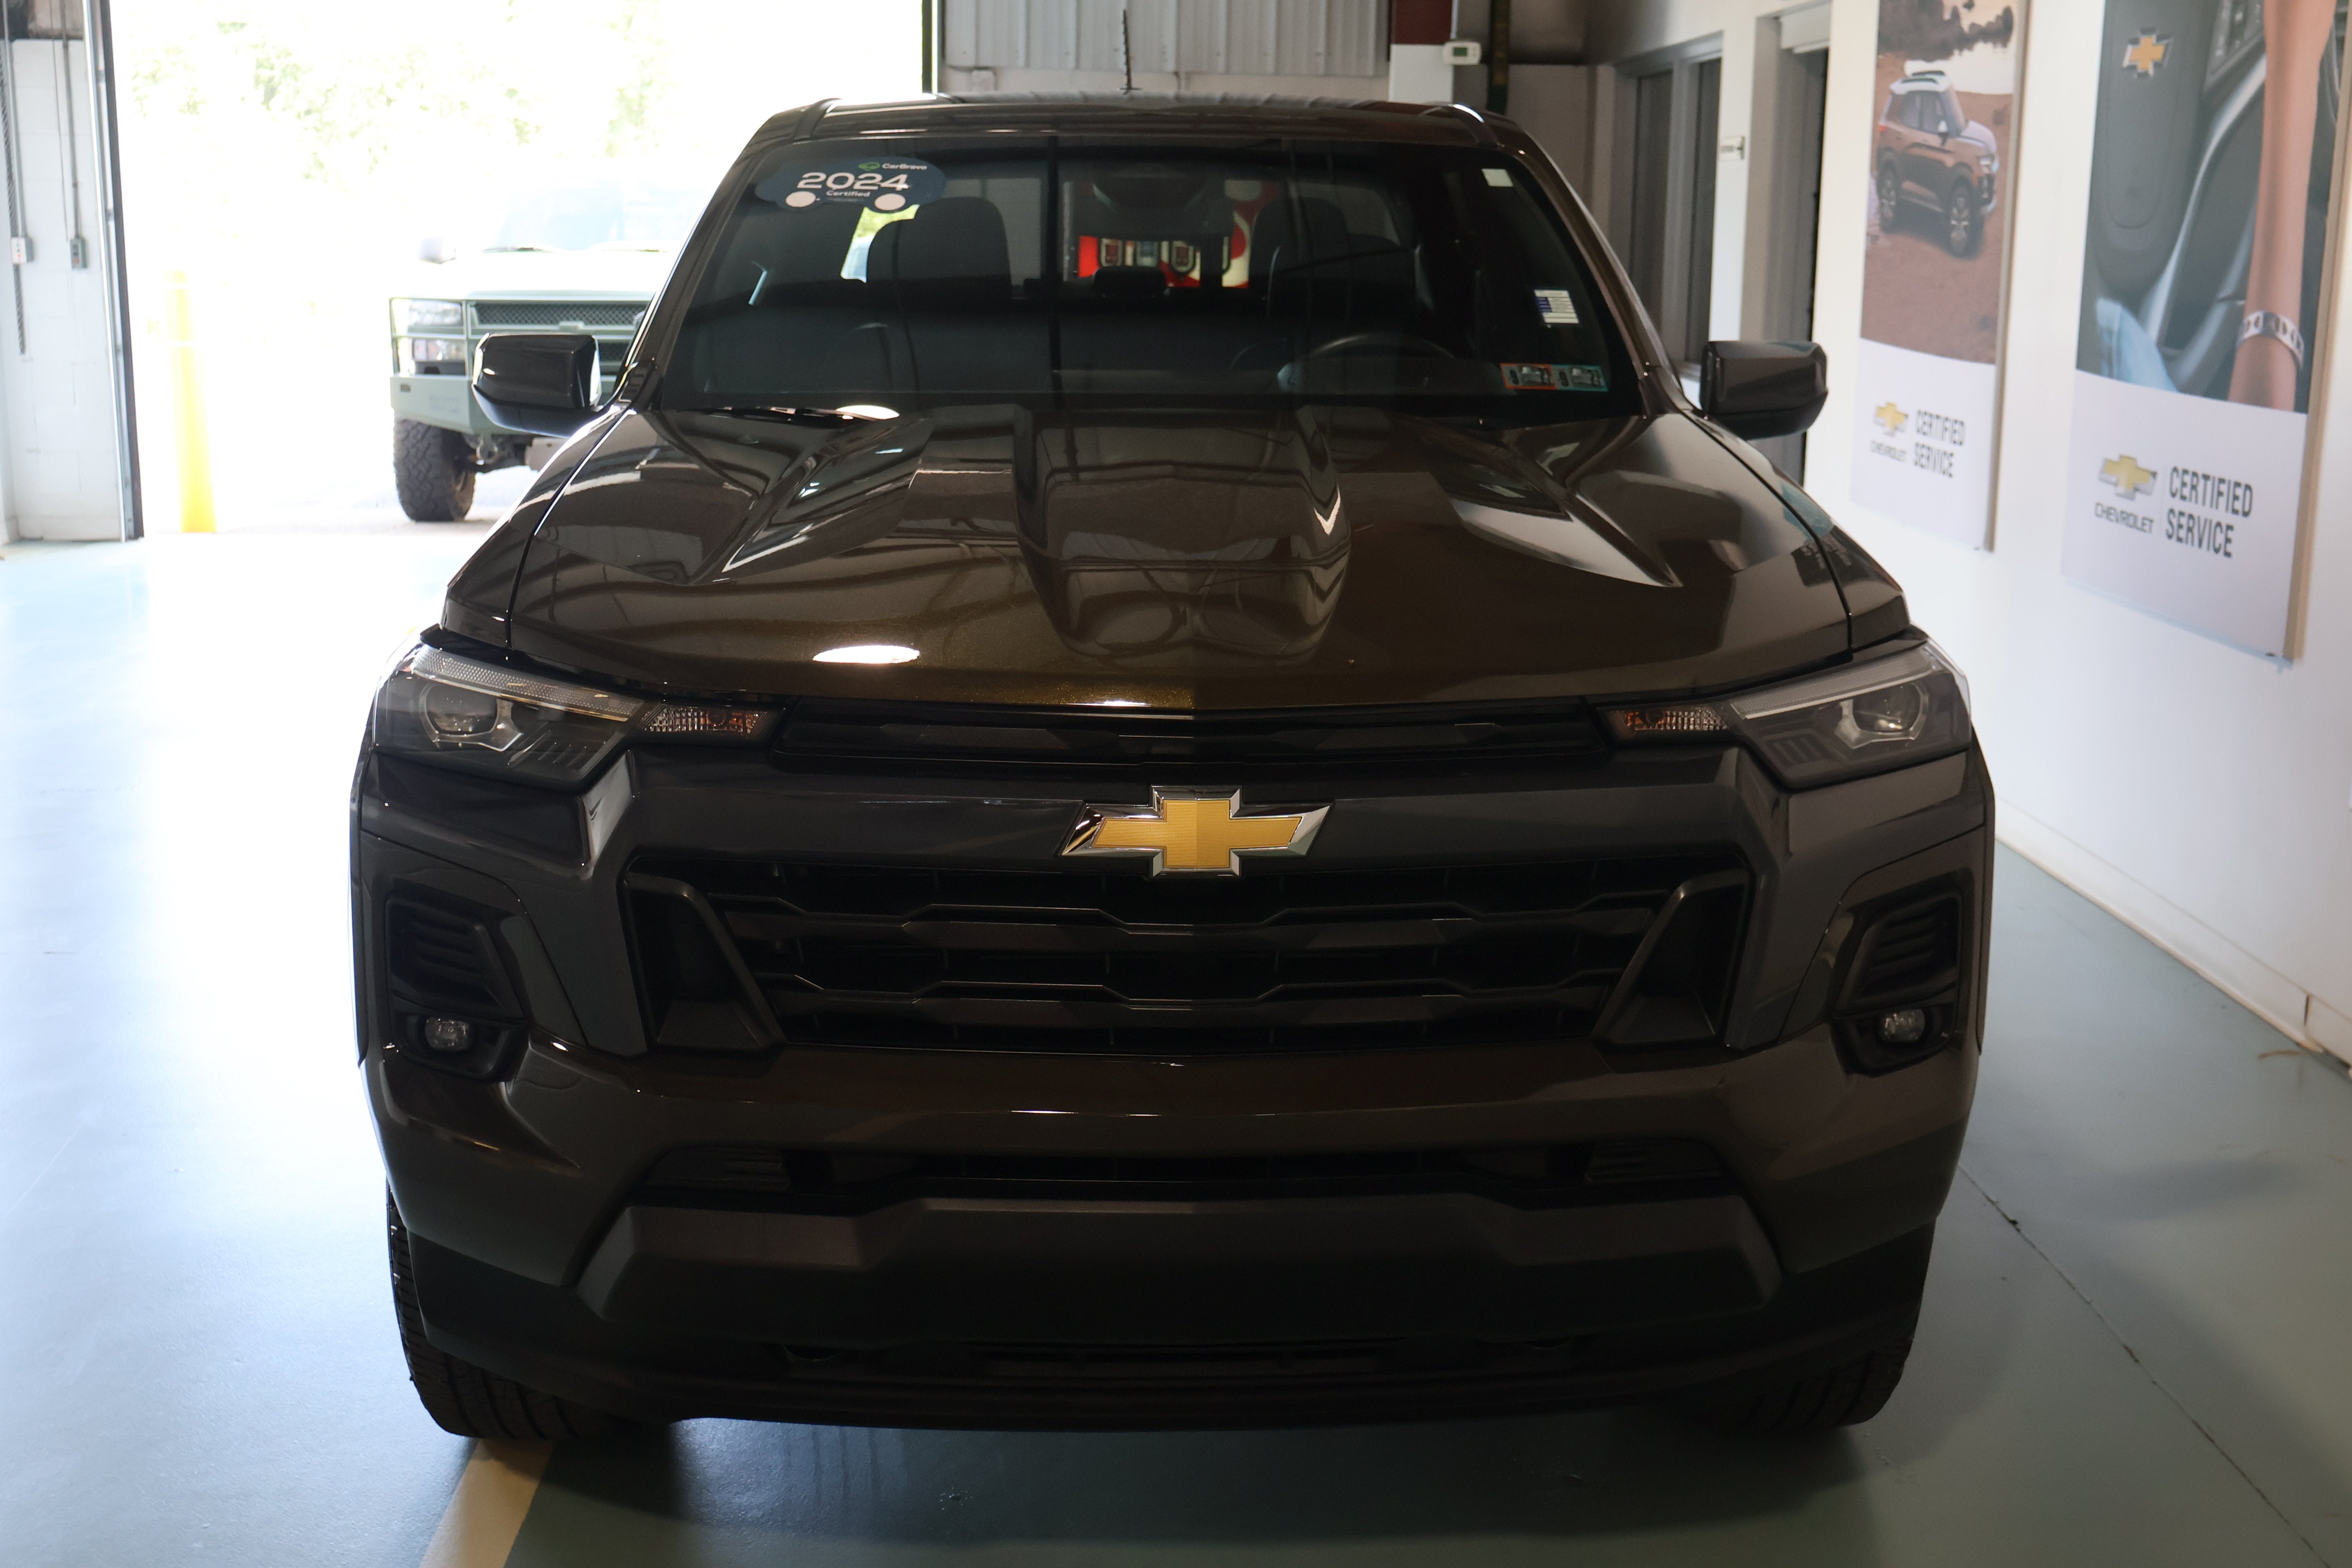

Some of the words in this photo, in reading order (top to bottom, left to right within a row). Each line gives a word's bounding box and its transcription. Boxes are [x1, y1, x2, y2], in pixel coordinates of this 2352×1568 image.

[797, 172, 909, 191] 2024
[1915, 409, 1966, 447] CERTIFIED
[1913, 442, 1954, 478] SERVICE
[2169, 466, 2253, 518] CERTIFIED
[2094, 502, 2154, 533] CHEVROLET
[2166, 508, 2234, 558] SERVICE
